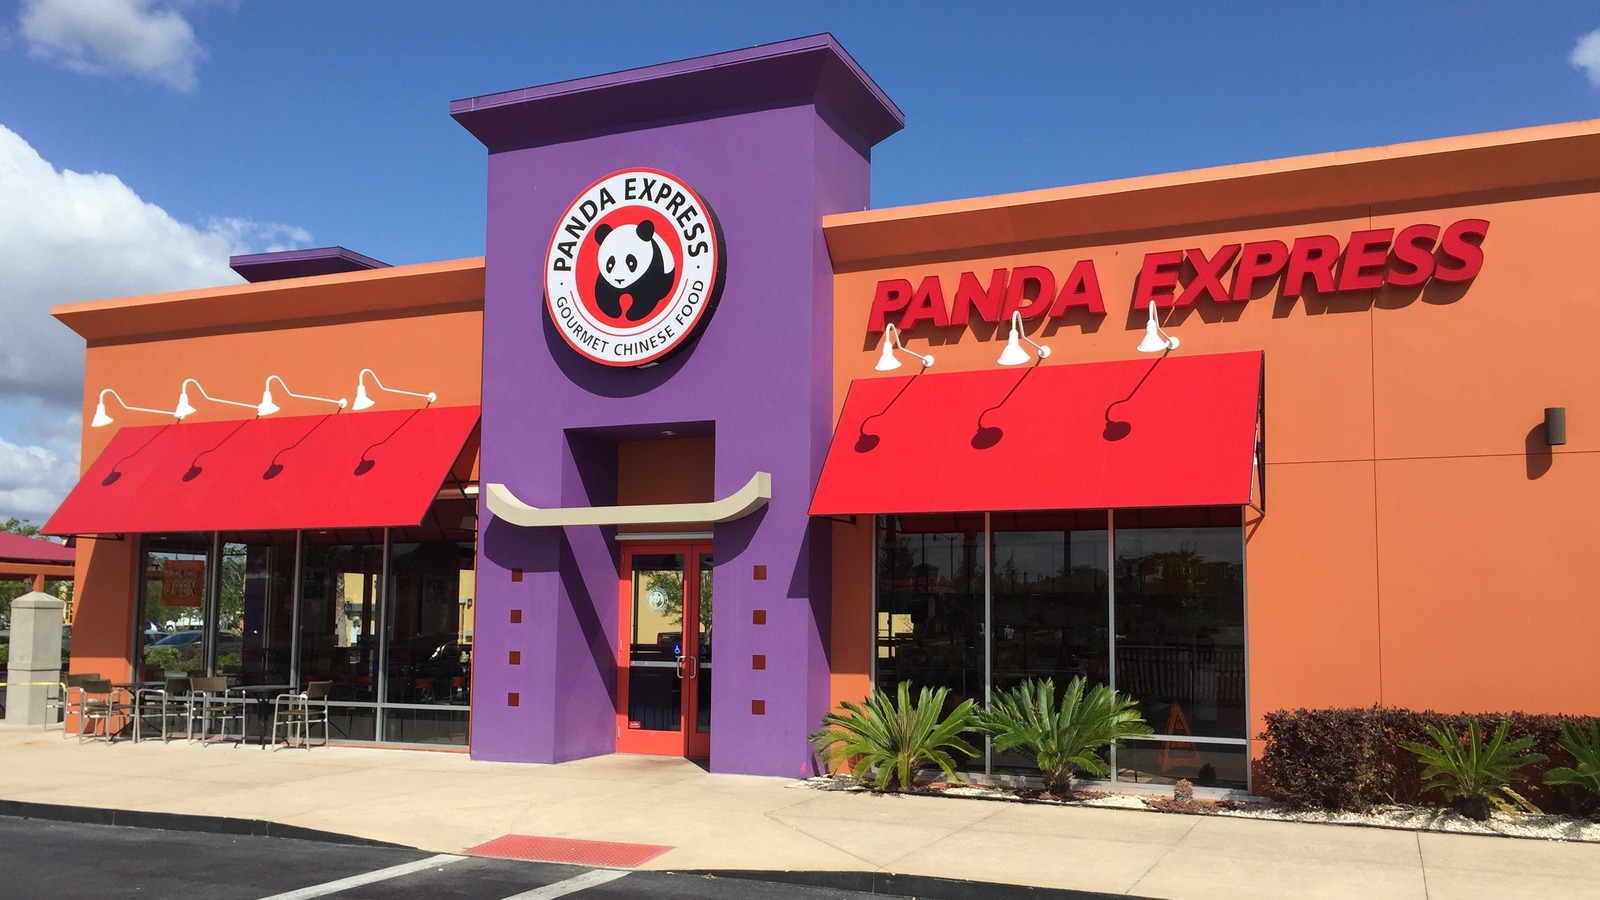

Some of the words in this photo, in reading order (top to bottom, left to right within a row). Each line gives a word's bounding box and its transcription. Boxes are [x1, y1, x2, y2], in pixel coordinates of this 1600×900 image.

[553, 187, 617, 272] PANDA
[624, 177, 709, 258] EXPRESS
[556, 296, 610, 353] GOURMET
[614, 325, 675, 356] CHINESE
[675, 280, 705, 326] FOOD
[867, 259, 1107, 333] PANDA
[1134, 218, 1491, 311] EXPRESS
[164, 580, 196, 597] OPEN
